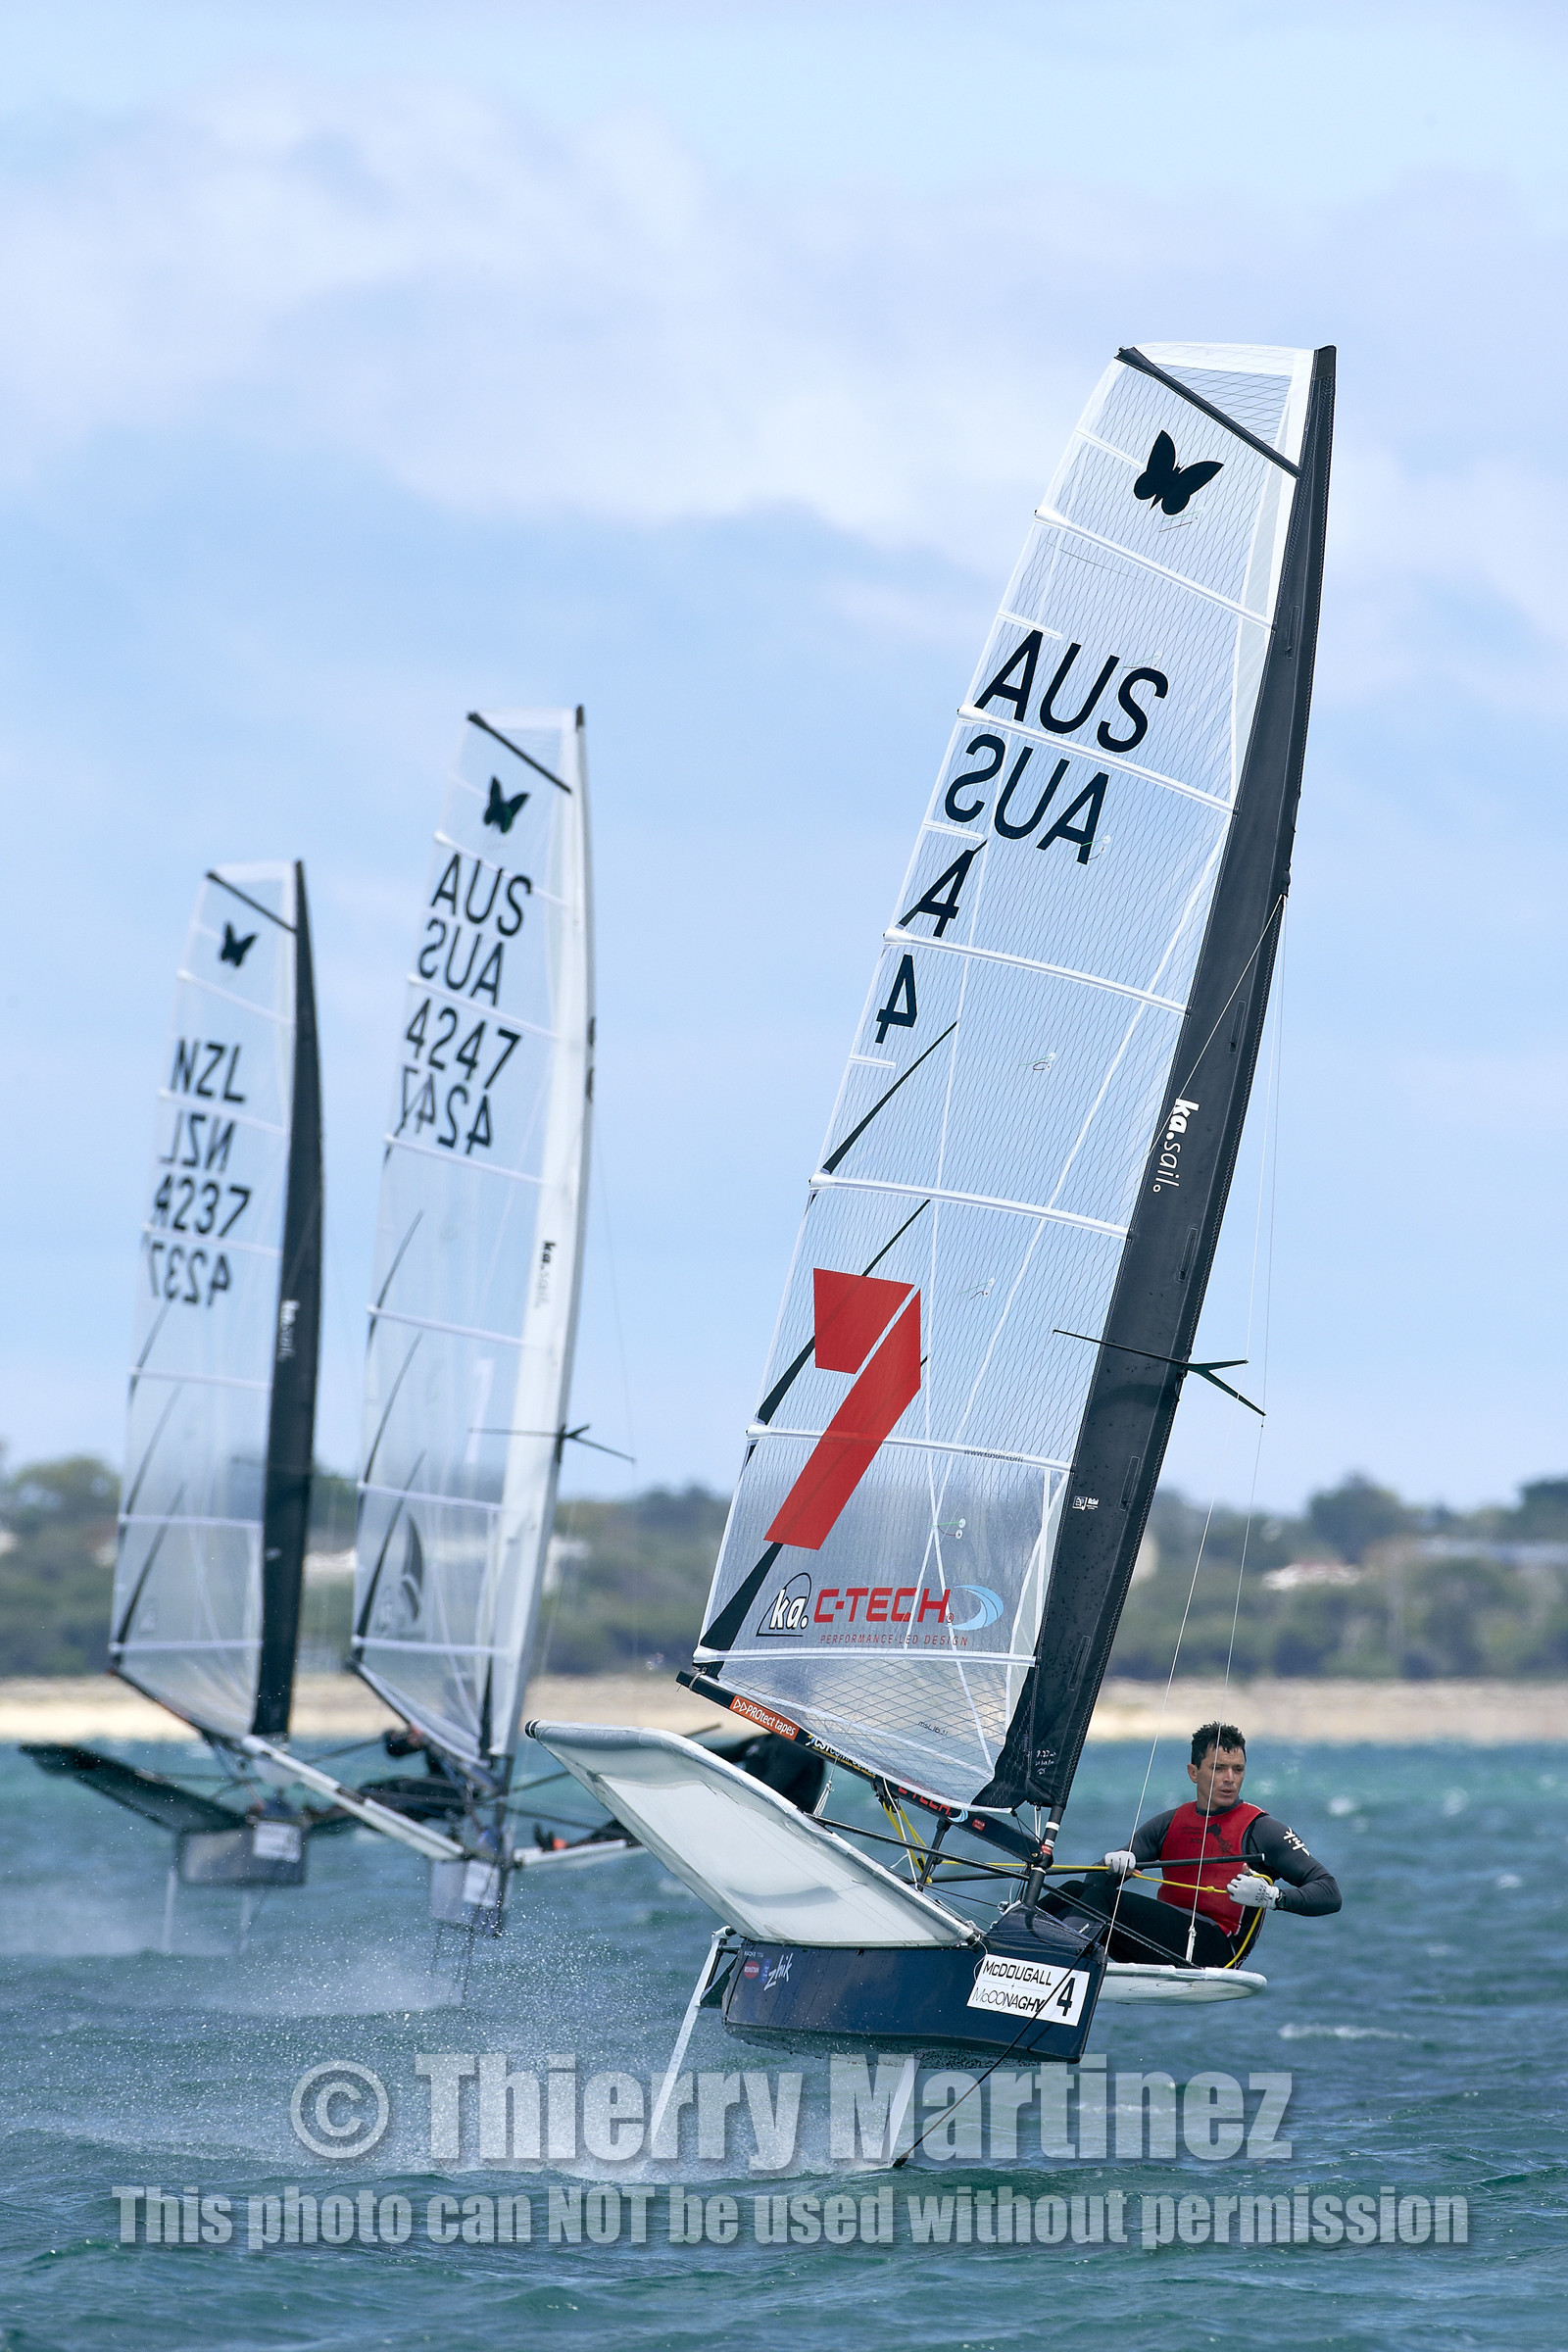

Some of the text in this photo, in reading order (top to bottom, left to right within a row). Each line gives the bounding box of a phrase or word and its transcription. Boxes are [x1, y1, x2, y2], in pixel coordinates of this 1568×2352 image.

[975, 630, 1168, 753] AUS
[430, 854, 532, 937] AUS
[916, 849, 975, 938] 4
[169, 1036, 246, 1103] NZL
[406, 999, 521, 1089] 4247
[153, 1174, 251, 1239] 4237
[763, 1268, 920, 1550] 7
[820, 1634, 968, 1646] PERFORMANCE-LED DESIGN
[774, 1718, 797, 1737] tapes
[982, 1960, 1053, 1986] McDOUGALL
[1056, 1978, 1076, 2017] 4
